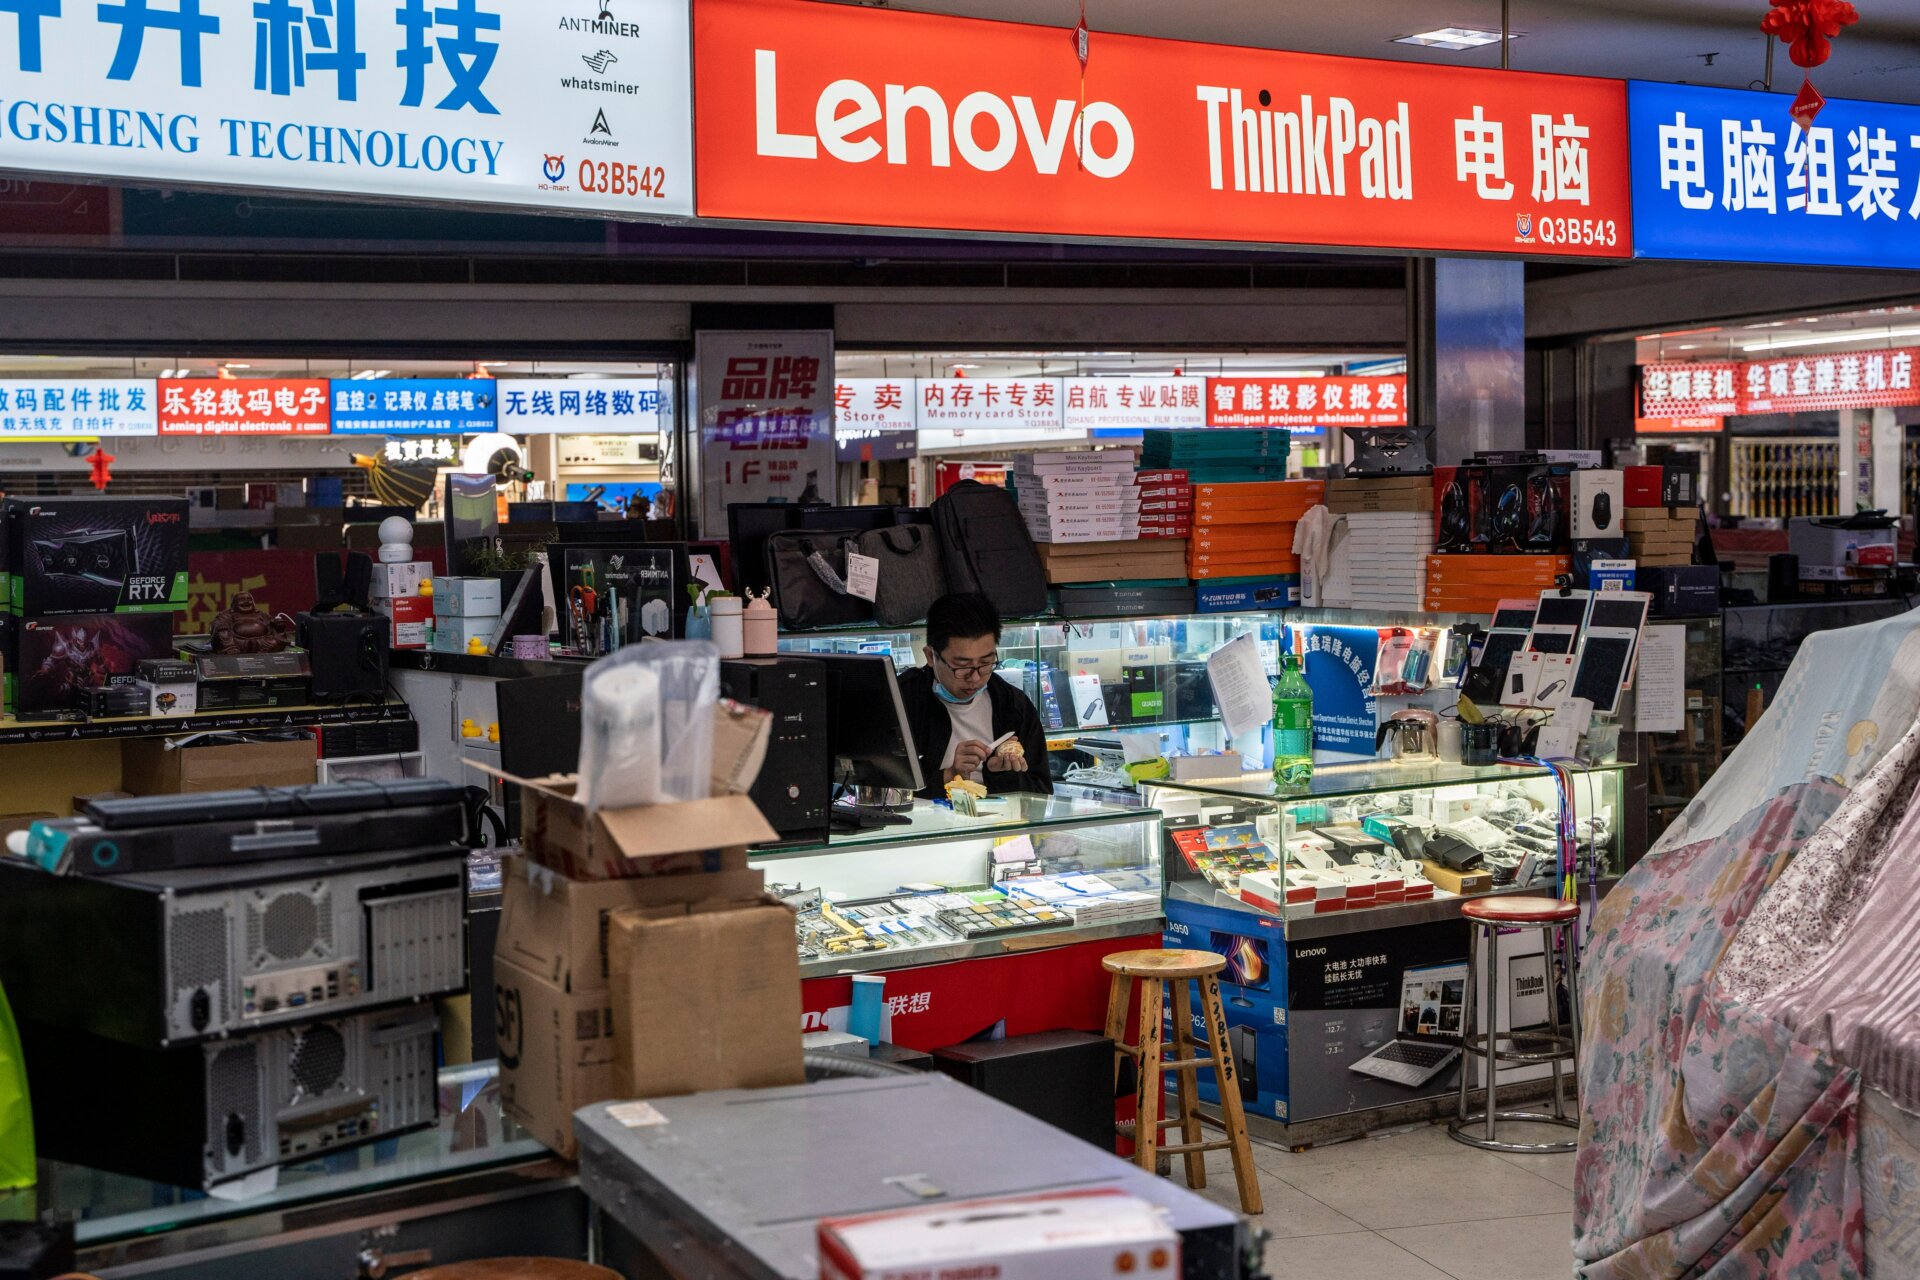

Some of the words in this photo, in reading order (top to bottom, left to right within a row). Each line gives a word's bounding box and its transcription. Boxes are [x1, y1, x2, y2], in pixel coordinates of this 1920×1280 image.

[559, 16, 640, 38] ANTMINER
[561, 77, 640, 95] whatsminer
[0, 100, 199, 153] GSHENG
[220, 118, 504, 176] TECHNOLOGY
[755, 49, 1135, 178] Lenovo
[1197, 84, 1416, 206] ThinkPad
[582, 137, 620, 148] AvalonMiner
[1454, 106, 1591, 206] 电脑
[579, 158, 666, 199] Q3B542
[1539, 216, 1617, 247] Q3B543
[721, 356, 820, 400] 品牌
[162, 387, 326, 416] 乐铭数码电子
[335, 390, 366, 412] 监控
[384, 390, 428, 412] 记录仪
[431, 390, 475, 412] 点读笔
[925, 383, 1054, 408] 内存卡专卖
[1067, 384, 1108, 409] 启航
[1116, 384, 1199, 409] 专业贴膜
[1214, 383, 1407, 411] 智能投影仪批发
[843, 411, 885, 422] Store
[928, 409, 981, 420] Memory
[985, 408, 1014, 418] card
[1018, 408, 1053, 418] Store
[1214, 413, 1265, 425] Intelligent
[1268, 413, 1312, 425] projector
[1316, 413, 1365, 423] wholesale
[162, 420, 203, 433] Leming
[203, 420, 239, 433] digital
[240, 420, 292, 432] electronic
[130, 576, 165, 585] GEFORCE
[129, 584, 165, 600] RTX
[1170, 922, 1189, 936] A950
[1295, 946, 1327, 959] Lenovo
[1325, 960, 1348, 972] 大电池
[1349, 954, 1388, 969] 大功率快充
[1516, 975, 1544, 991] ThinkBook
[888, 991, 931, 1017] 联想
